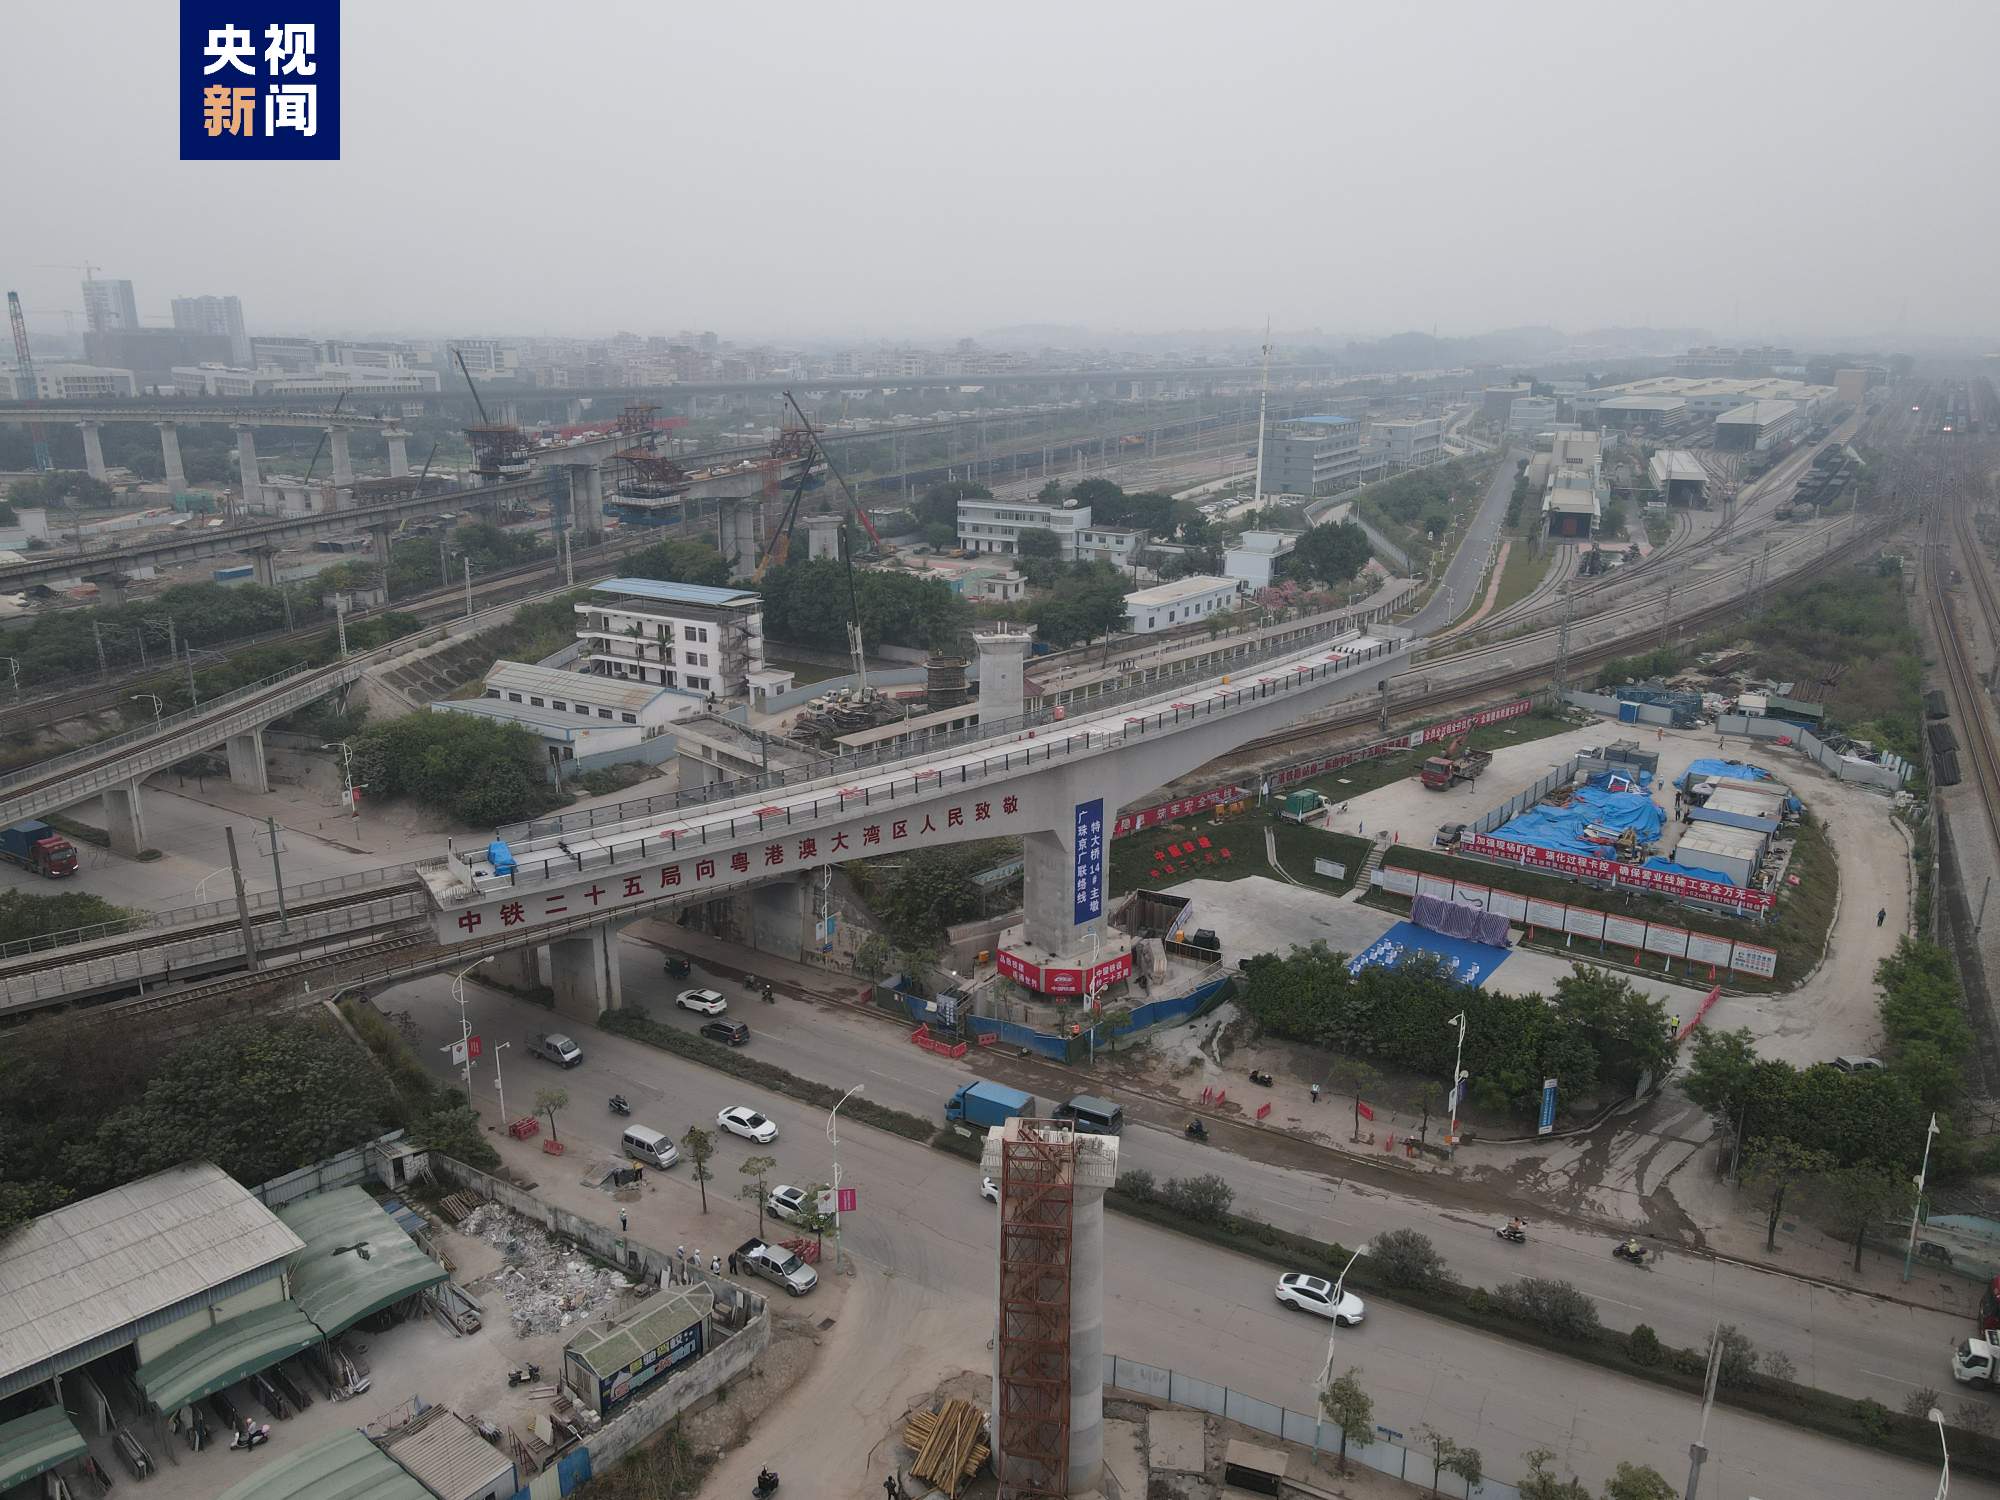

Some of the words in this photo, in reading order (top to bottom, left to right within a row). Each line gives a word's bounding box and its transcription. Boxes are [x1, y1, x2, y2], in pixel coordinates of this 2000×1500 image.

[457, 795, 1018, 934] 中铁二十五局向粤港澳大湾区人民致敬
[1077, 811, 1088, 904] 广珠京广联络线
